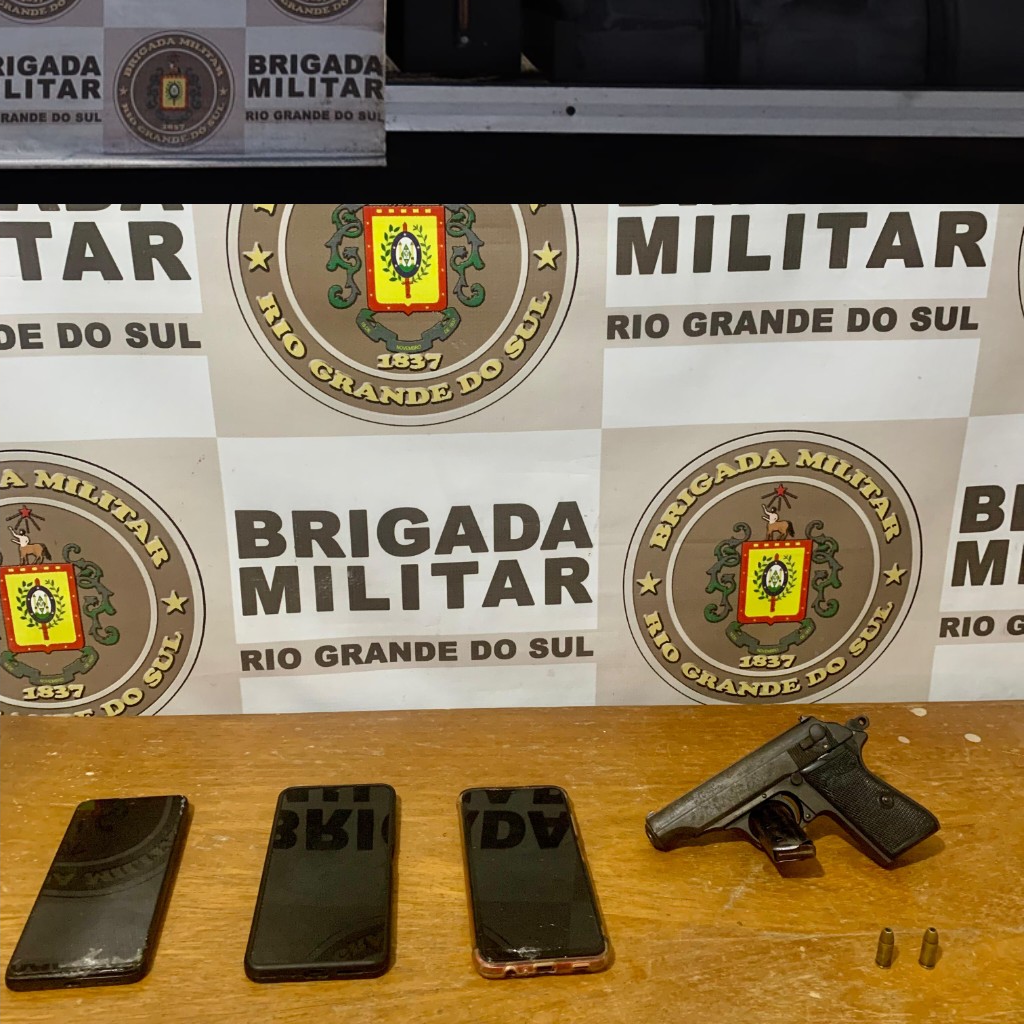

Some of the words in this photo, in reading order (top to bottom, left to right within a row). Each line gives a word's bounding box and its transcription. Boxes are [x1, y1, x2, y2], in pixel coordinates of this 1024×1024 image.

[50, 0, 66, 12] DO
[125, 38, 176, 77] BRIGADA
[180, 39, 223, 77] MILITAR
[249, 54, 382, 75] BRIGADA
[248, 78, 384, 99] MILITAR
[52, 112, 70, 122] DO
[76, 112, 101, 122] SUL
[122, 103, 137, 126] RIO
[138, 126, 189, 144] GRANDE
[191, 126, 207, 140] DO
[207, 104, 224, 128] SUL
[246, 111, 268, 121] RIO
[273, 111, 330, 121] GRANDE
[335, 111, 353, 121] DO
[358, 111, 384, 122] SUL
[615, 210, 988, 275] MILITAR
[57, 322, 111, 348] DO
[125, 322, 201, 349] SUL
[607, 313, 670, 340] RIO
[682, 308, 833, 337] GRANDE
[847, 307, 898, 332] DO
[910, 306, 979, 331] SUL
[256, 292, 307, 359] RIO
[308, 358, 453, 406] GRANDE
[457, 357, 503, 396] DO
[504, 290, 552, 359] SUL
[377, 353, 443, 371] 1837
[650, 449, 788, 550] BRIGADA
[796, 448, 902, 543] MILITAR
[34, 469, 170, 569] MILITAR
[234, 501, 594, 559] BRIGADA
[239, 557, 594, 617] MILITAR
[939, 616, 995, 638] RIO
[240, 648, 302, 671] RIO
[314, 641, 458, 668] GRANDE
[470, 639, 517, 661] DO
[529, 636, 594, 659] SUL
[644, 610, 680, 664] RIO
[680, 662, 801, 696] GRANDE
[806, 656, 846, 686] DO
[848, 602, 894, 656] SUL
[740, 655, 796, 669] 1837
[101, 687, 144, 716] DO
[144, 631, 183, 689] SUL
[22, 683, 85, 701] 1837
